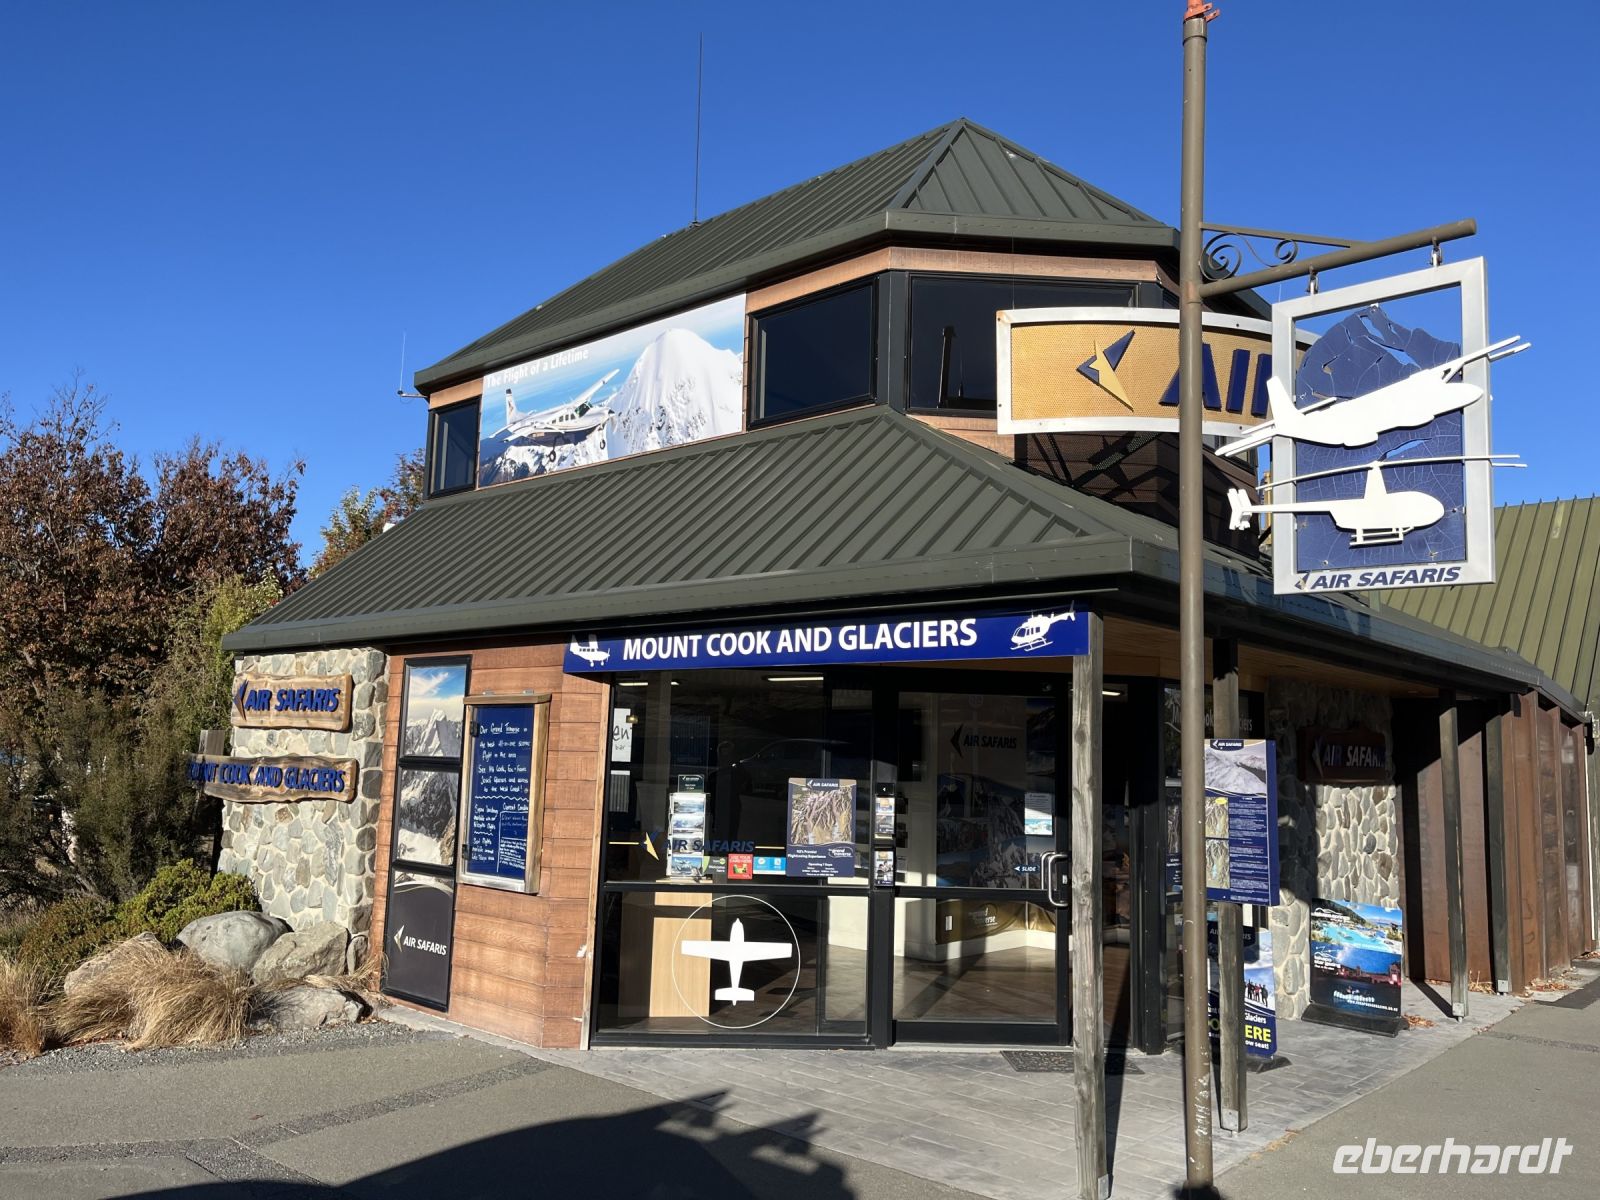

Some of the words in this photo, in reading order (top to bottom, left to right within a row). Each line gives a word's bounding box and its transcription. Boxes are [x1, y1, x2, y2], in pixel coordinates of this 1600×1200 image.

[486, 375, 502, 388] The
[504, 366, 528, 384] Flight
[530, 362, 541, 375] of
[543, 361, 548, 371] a
[551, 349, 589, 369] Lifetime
[1311, 574, 1351, 589] AIR
[1357, 567, 1462, 587] SAFARIS
[623, 635, 702, 660] MOUNT
[706, 631, 772, 657] COOK
[776, 627, 832, 654] AND
[838, 619, 977, 651] GLACIERS
[245, 689, 272, 711] AIR
[275, 688, 341, 712] SAFARIS
[964, 735, 979, 747] AIR
[981, 736, 1017, 749] SAFARIS
[218, 763, 252, 785] COOK
[254, 766, 283, 788] AND
[284, 767, 346, 792] GLACIERS
[662, 840, 687, 851] AIR
[692, 840, 754, 852] SAFARIS
[403, 936, 416, 948] AIR
[417, 939, 447, 955] SAFARIS
